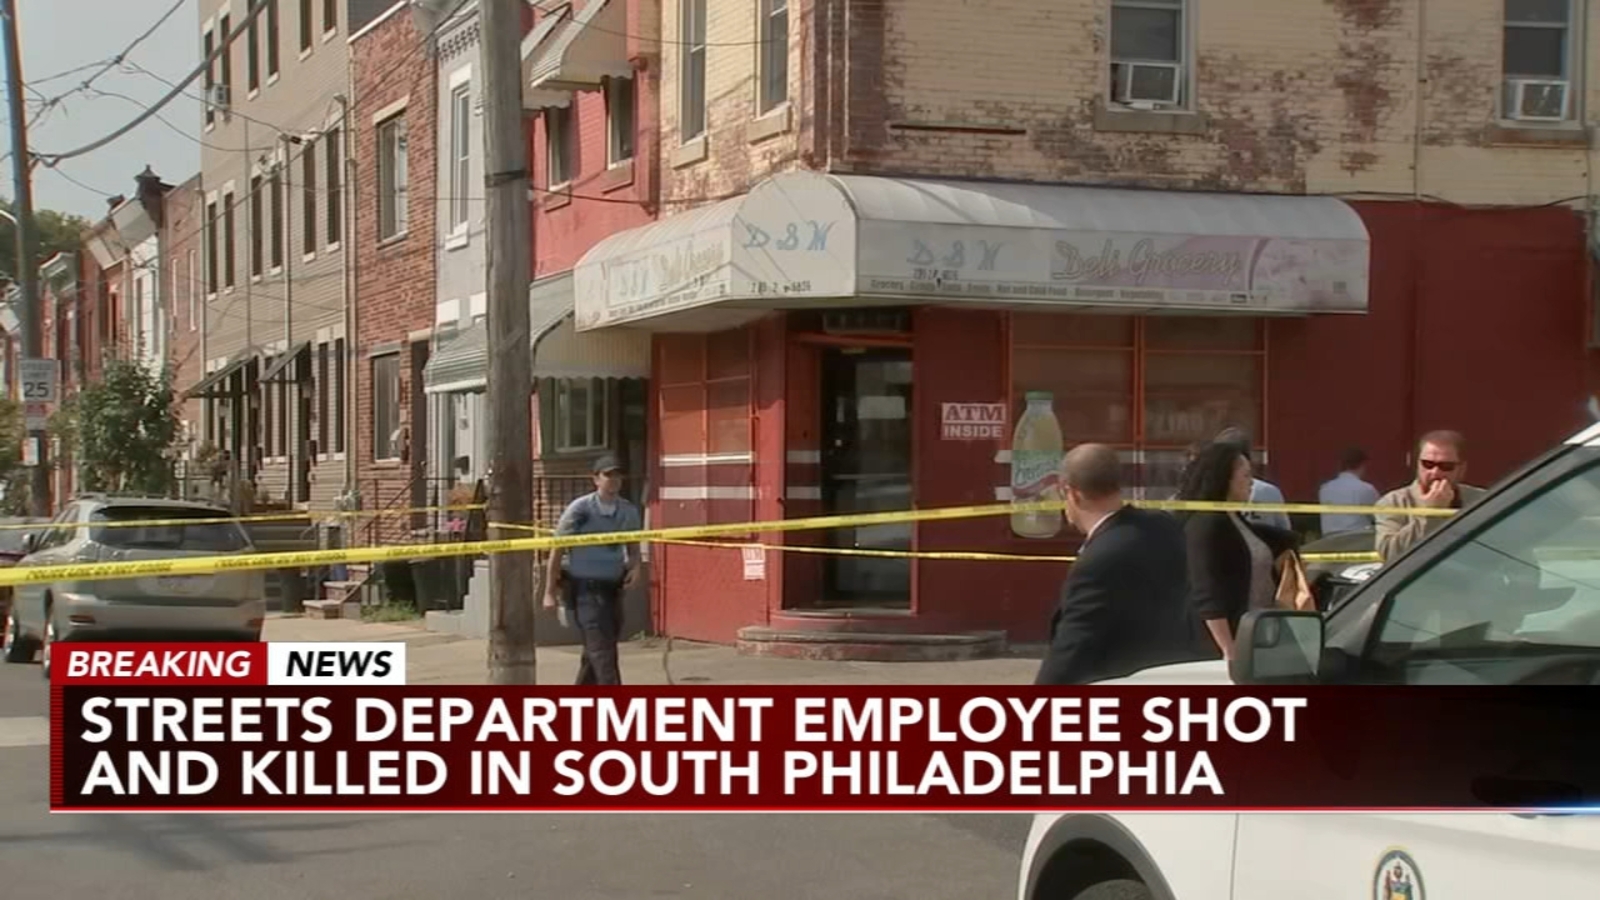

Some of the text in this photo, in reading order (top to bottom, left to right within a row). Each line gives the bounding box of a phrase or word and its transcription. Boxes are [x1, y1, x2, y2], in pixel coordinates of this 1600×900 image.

[1052, 238, 1241, 286] Deli Grocery
[23, 381, 49, 398] 25
[944, 404, 1005, 422] ATM
[944, 425, 1003, 438] INSIDE
